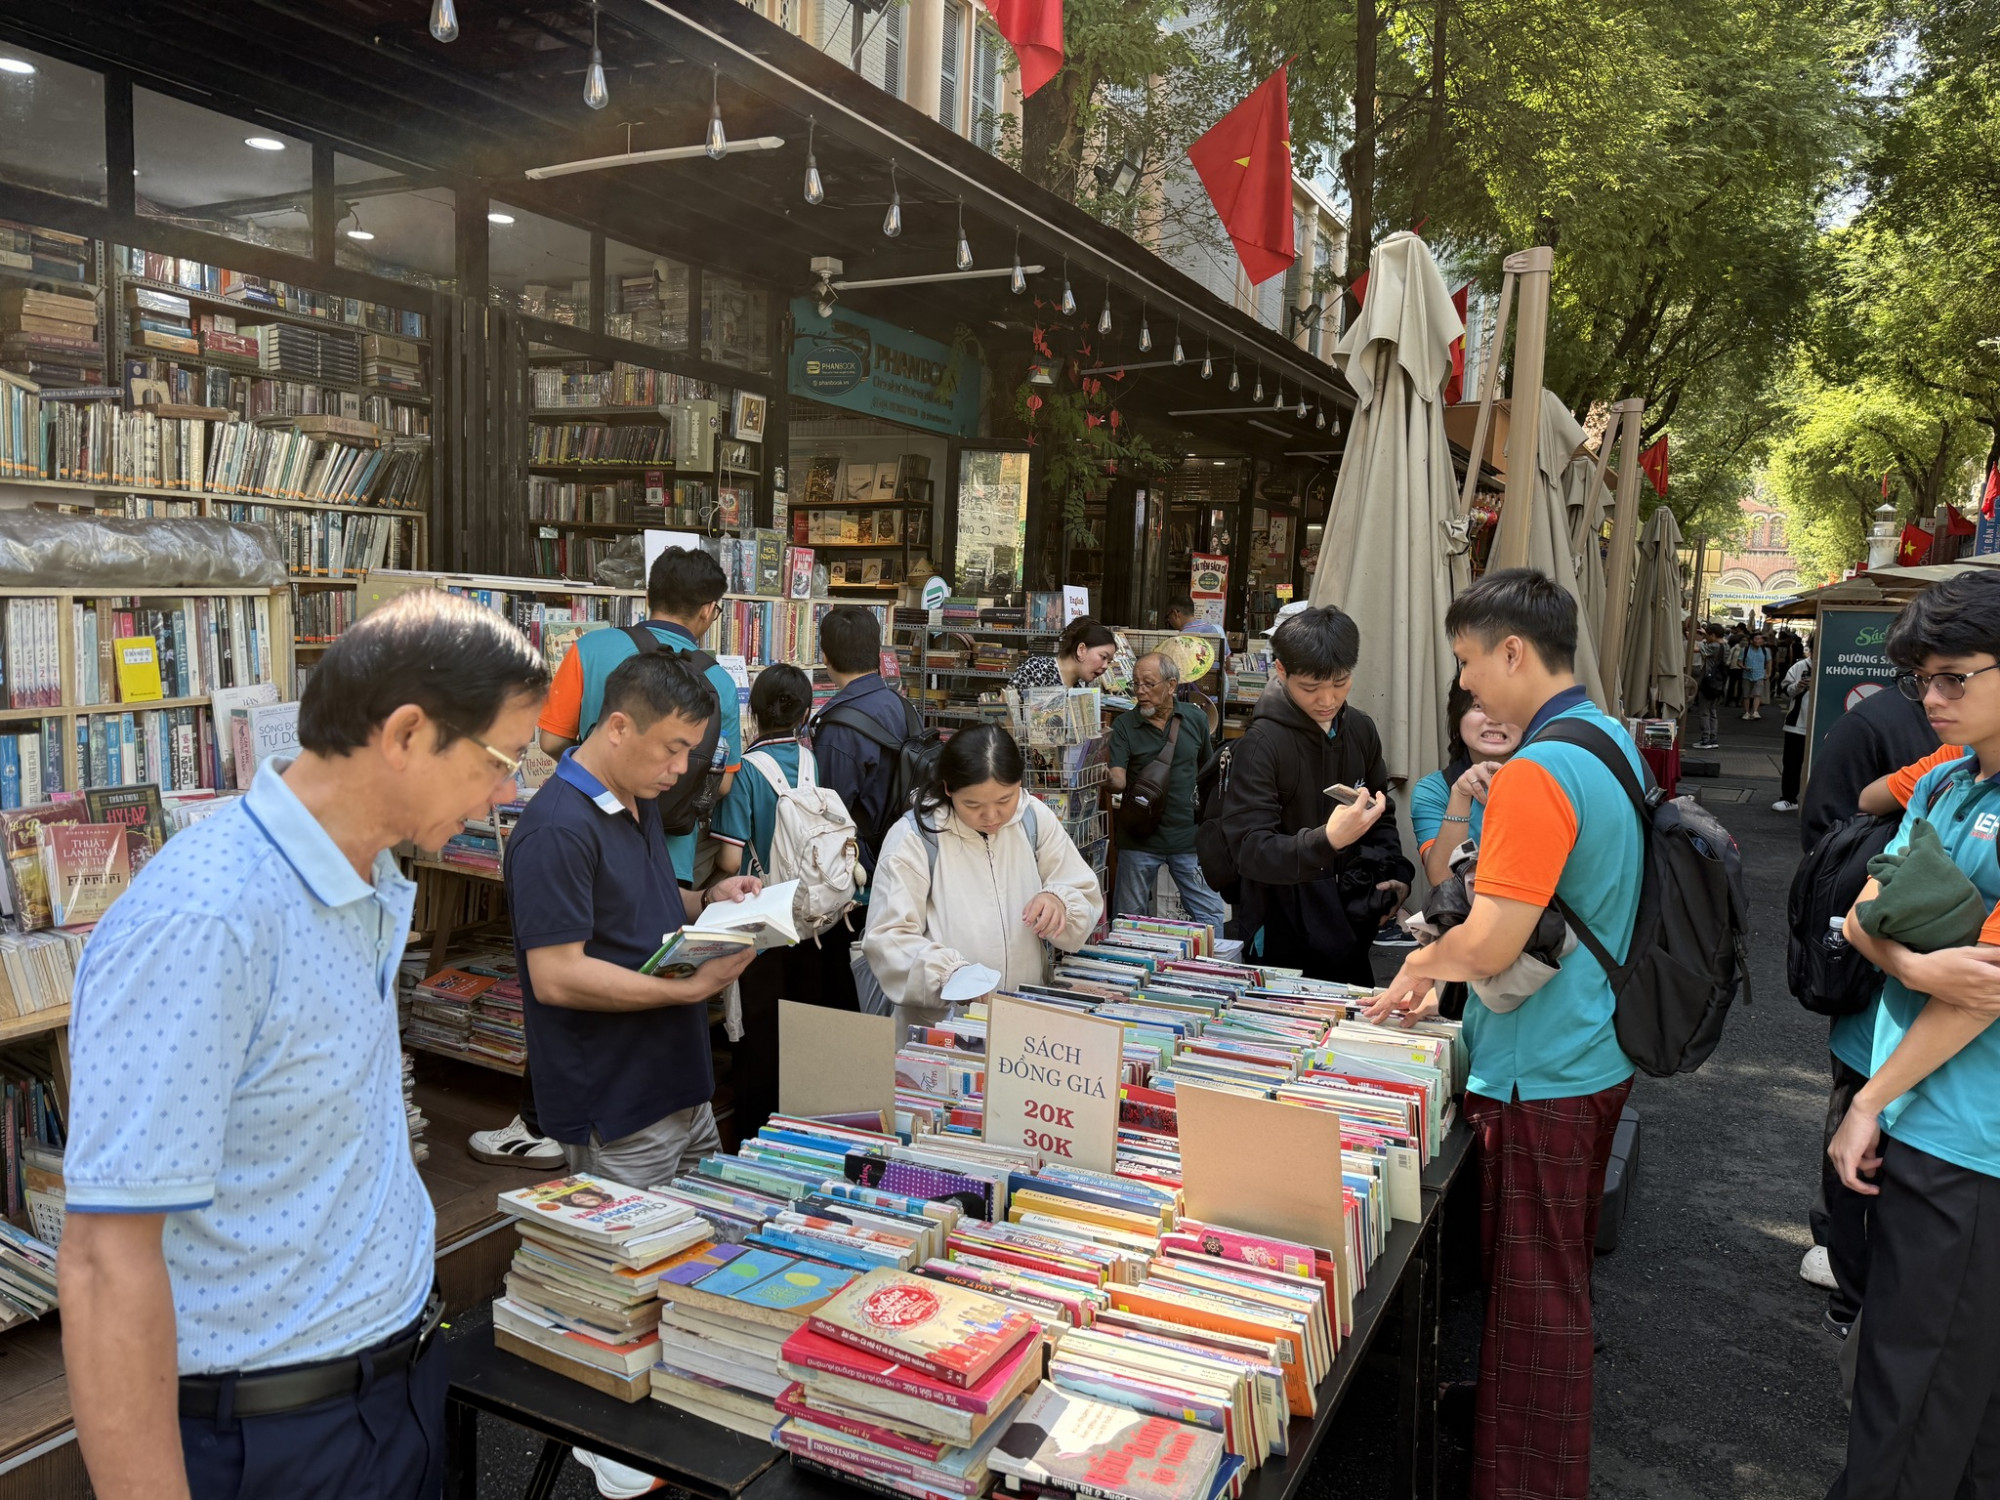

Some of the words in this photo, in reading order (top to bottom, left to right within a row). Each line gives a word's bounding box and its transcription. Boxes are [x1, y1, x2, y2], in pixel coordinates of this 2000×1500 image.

[821, 362, 856, 370] PHANBOOK
[1069, 595, 1084, 606] English
[1071, 608, 1083, 616] Books
[1838, 653, 1878, 664] ĐƯỜNG
[1826, 665, 1864, 676] KHÔNG
[1866, 666, 1898, 678] THUỐ
[259, 722, 284, 735] SỐNG
[261, 734, 278, 748] TỰ
[71, 839, 107, 848] THUẬT
[67, 873, 121, 886] Ferrari
[1023, 1035, 1081, 1065] SÁCH
[998, 1054, 1062, 1087] ĐỒNG
[1067, 1076, 1106, 1099] GIÁ
[1024, 1099, 1074, 1128] 20K
[1023, 1128, 1073, 1158] 30K
[967, 1280, 994, 1293] LUẬT
[813, 1441, 859, 1461] MONTESSORI
